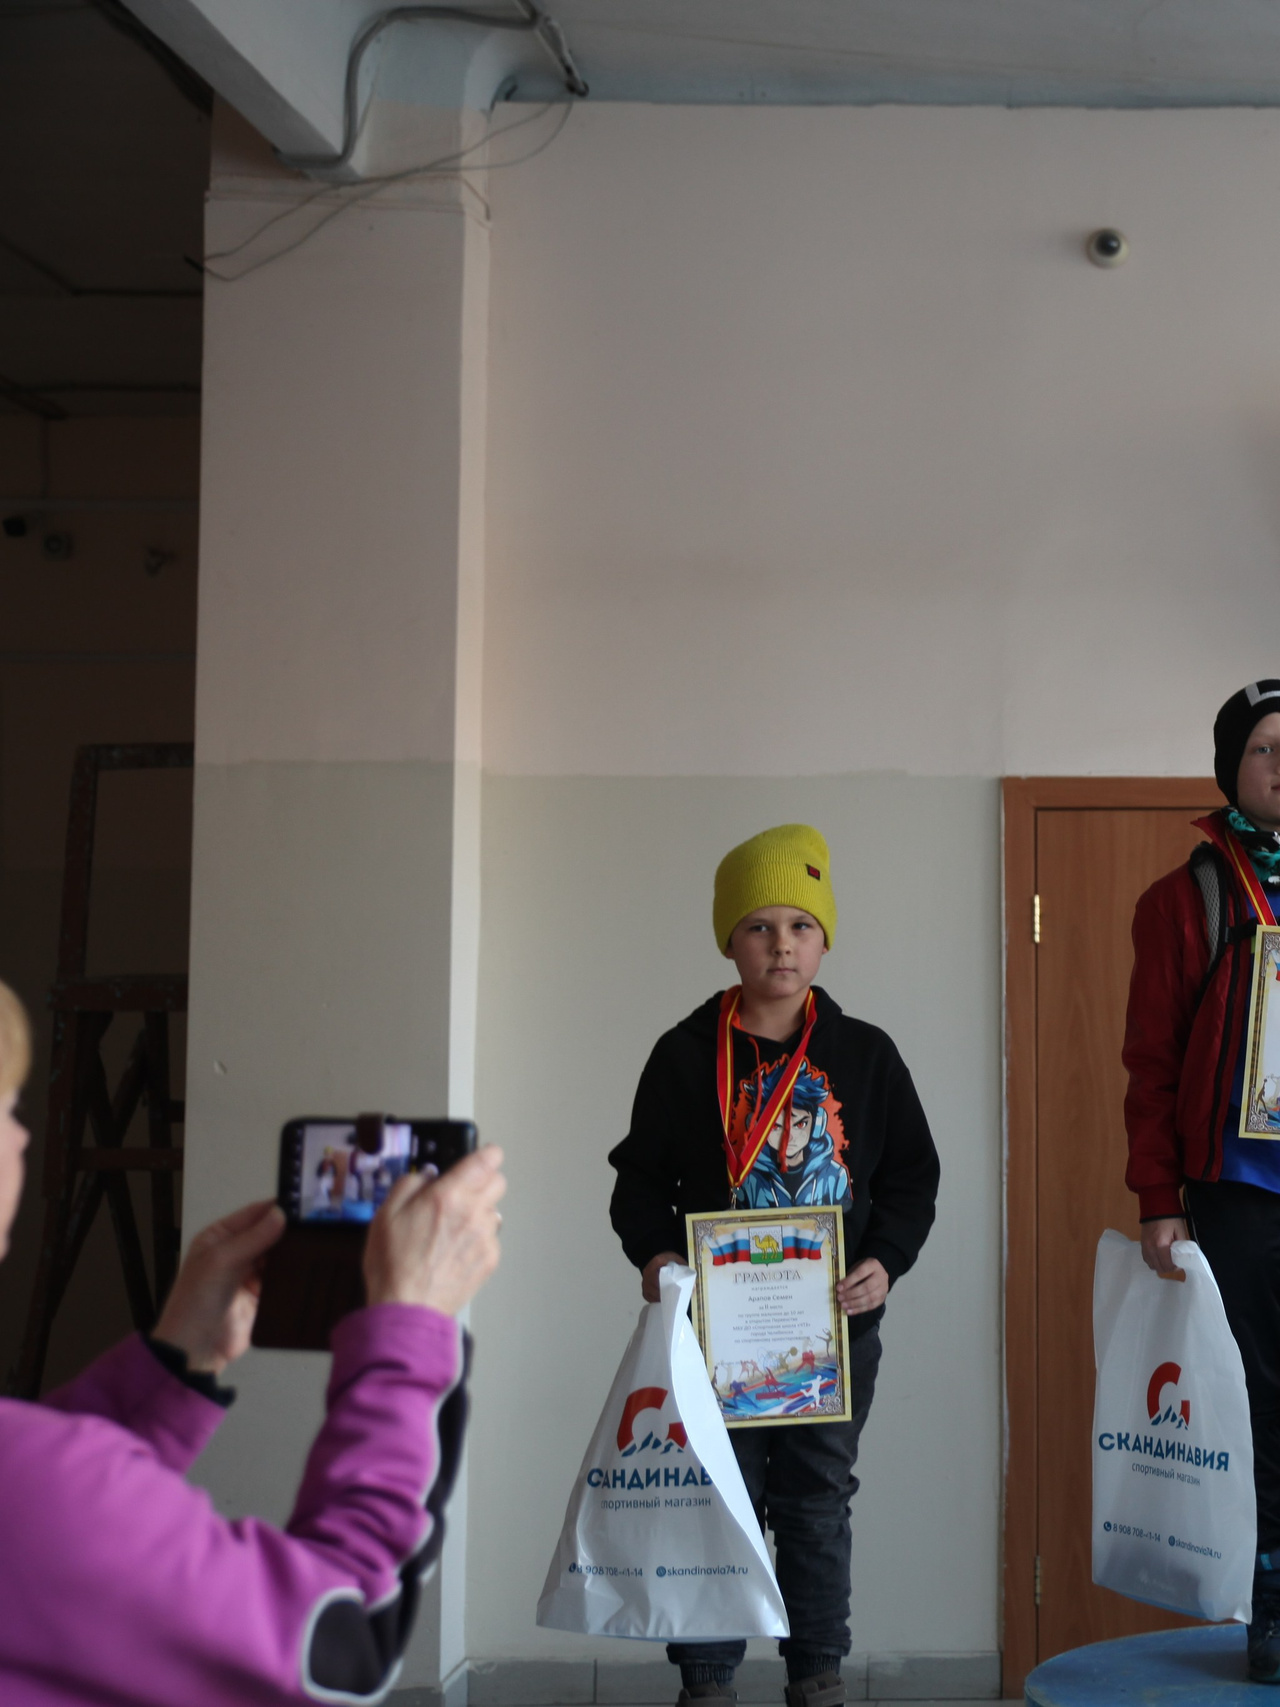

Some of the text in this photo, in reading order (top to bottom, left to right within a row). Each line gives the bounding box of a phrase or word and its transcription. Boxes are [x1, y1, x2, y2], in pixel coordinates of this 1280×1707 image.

[734, 1269, 802, 1284] ГРАМОТА
[1098, 1432, 1230, 1472] СКАНДИНАВИЯ
[1131, 1462, 1200, 1487] спортивный магазин
[664, 1497, 711, 1508] магазин
[1119, 1524, 1131, 1536] 908
[585, 1564, 604, 1575] 908
[667, 1564, 748, 1577] skandinavia74.ru
